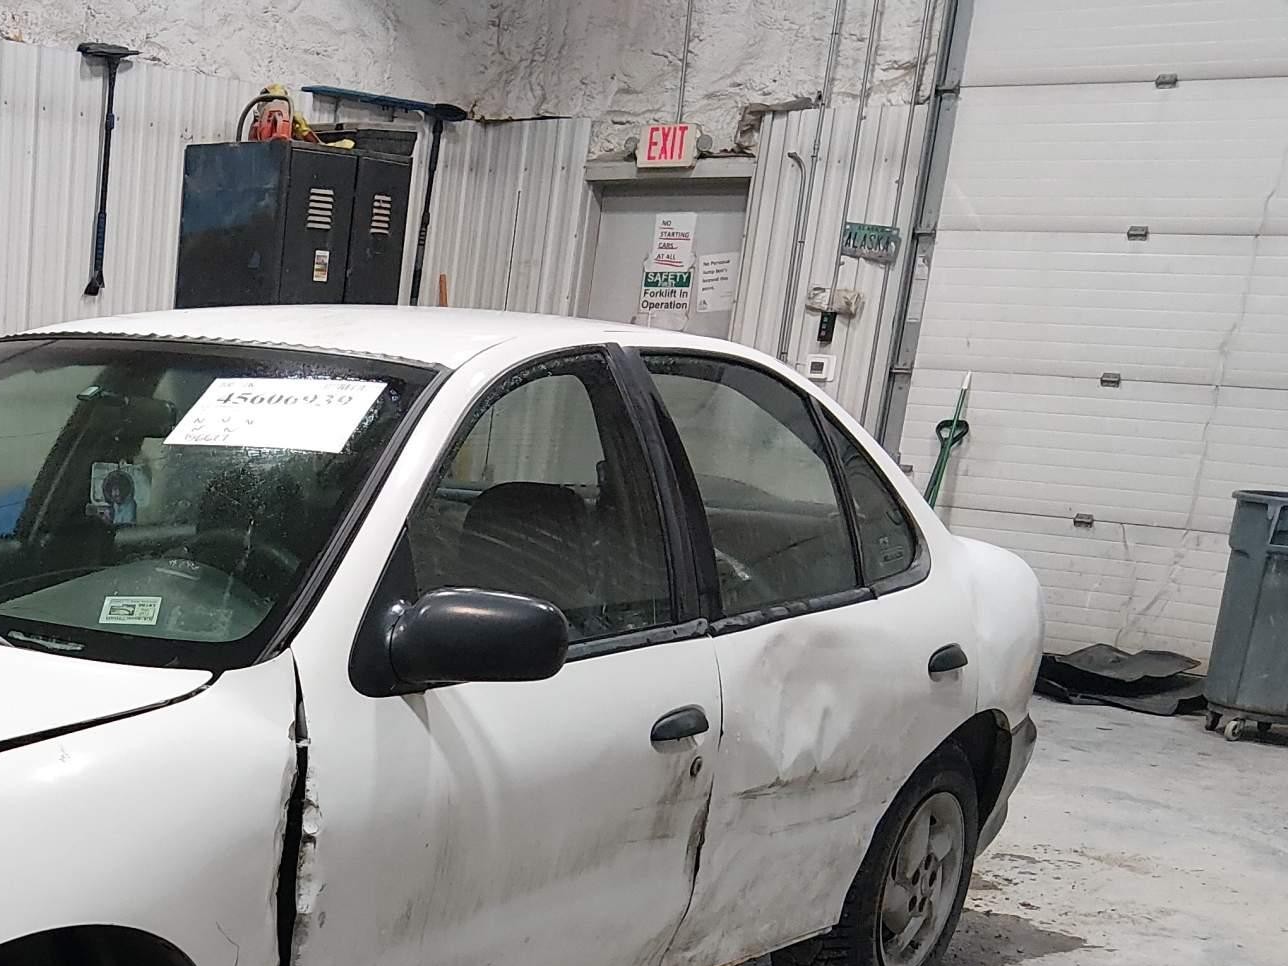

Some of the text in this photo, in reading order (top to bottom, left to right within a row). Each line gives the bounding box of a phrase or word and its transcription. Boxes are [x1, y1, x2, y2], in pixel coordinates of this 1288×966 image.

[647, 125, 689, 161] EXIT
[662, 219, 672, 227] NO
[844, 231, 890, 251] ALASKA
[647, 272, 688, 282] SAFETY
[643, 288, 688, 299] Forklift In
[641, 300, 688, 311] Operation
[216, 391, 354, 407] 45606939
